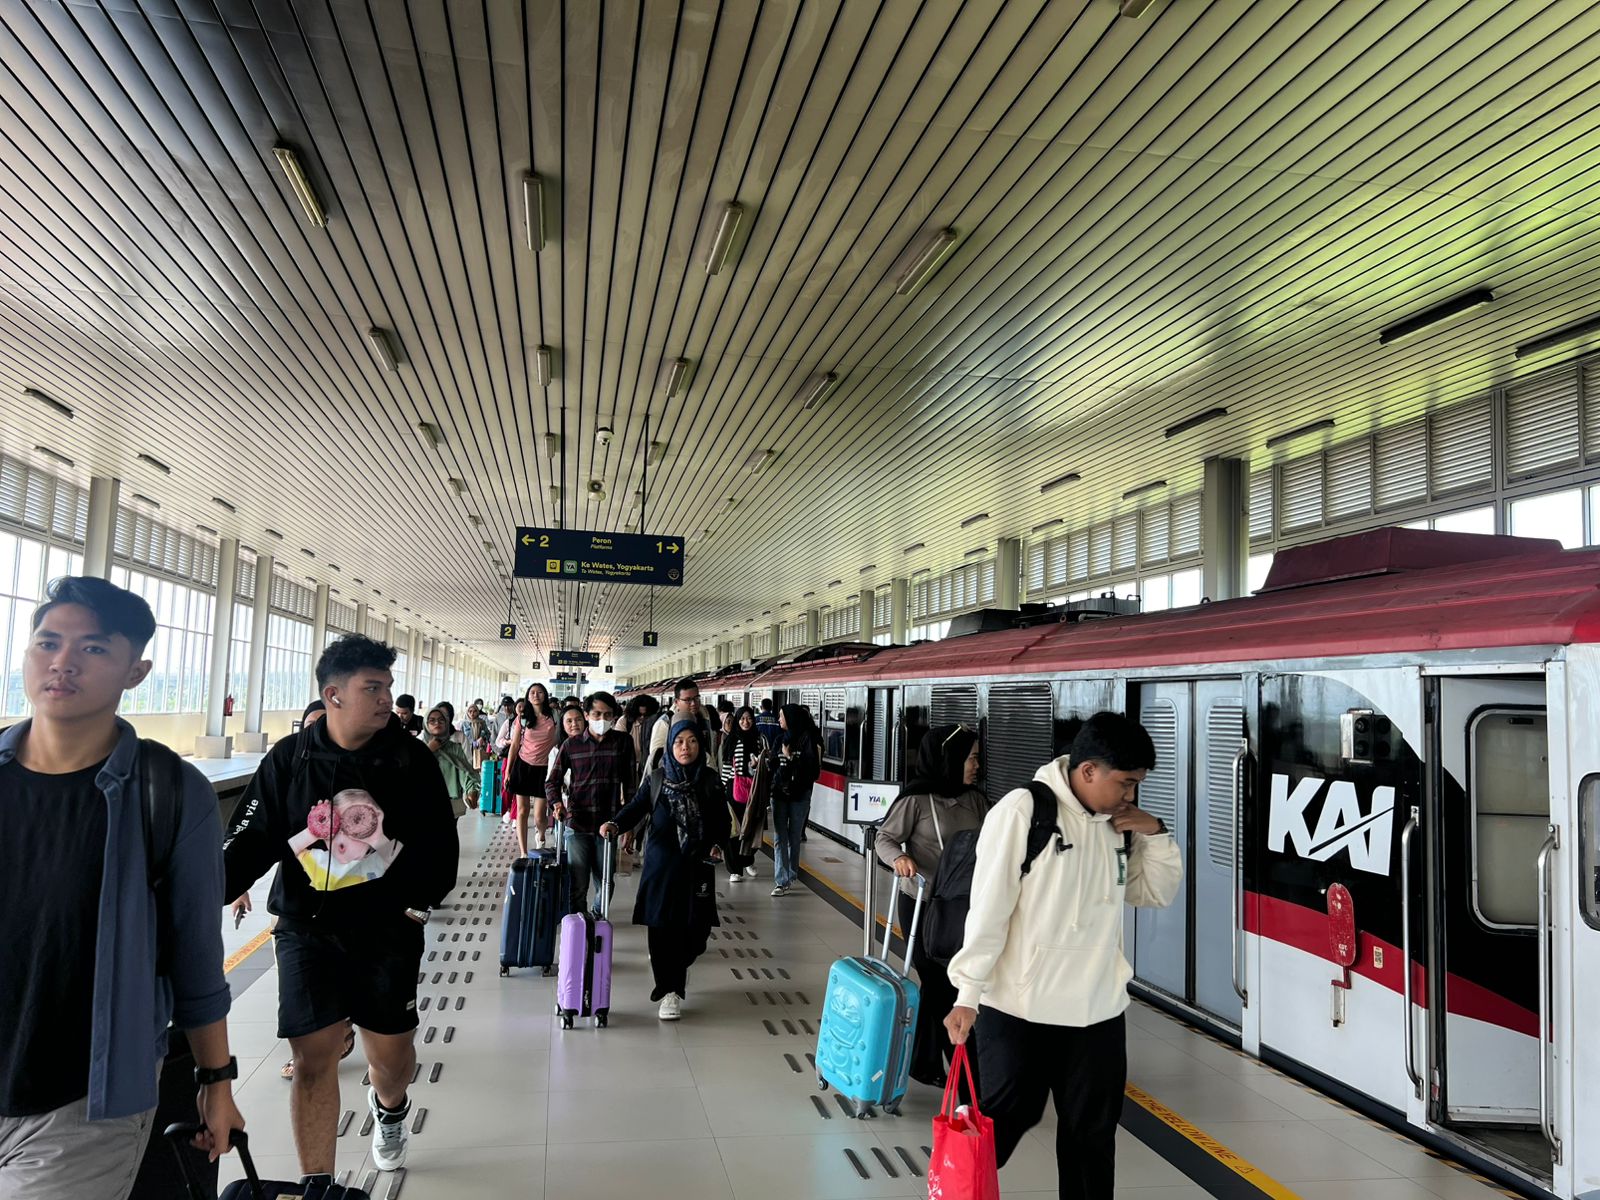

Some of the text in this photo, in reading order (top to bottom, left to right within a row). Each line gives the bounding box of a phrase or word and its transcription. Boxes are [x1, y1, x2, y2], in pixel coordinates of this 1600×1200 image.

[539, 535, 550, 548] 2
[592, 536, 612, 544] Peron
[656, 541, 663, 553] 1
[581, 561, 655, 572] Ke Wates, Yogyakarta
[504, 627, 512, 637] 2
[647, 635, 653, 644] 1
[245, 799, 259, 816] vie
[851, 793, 858, 811] 1
[1268, 773, 1395, 877] KAI
[1162, 1111, 1208, 1143] YELLOW
